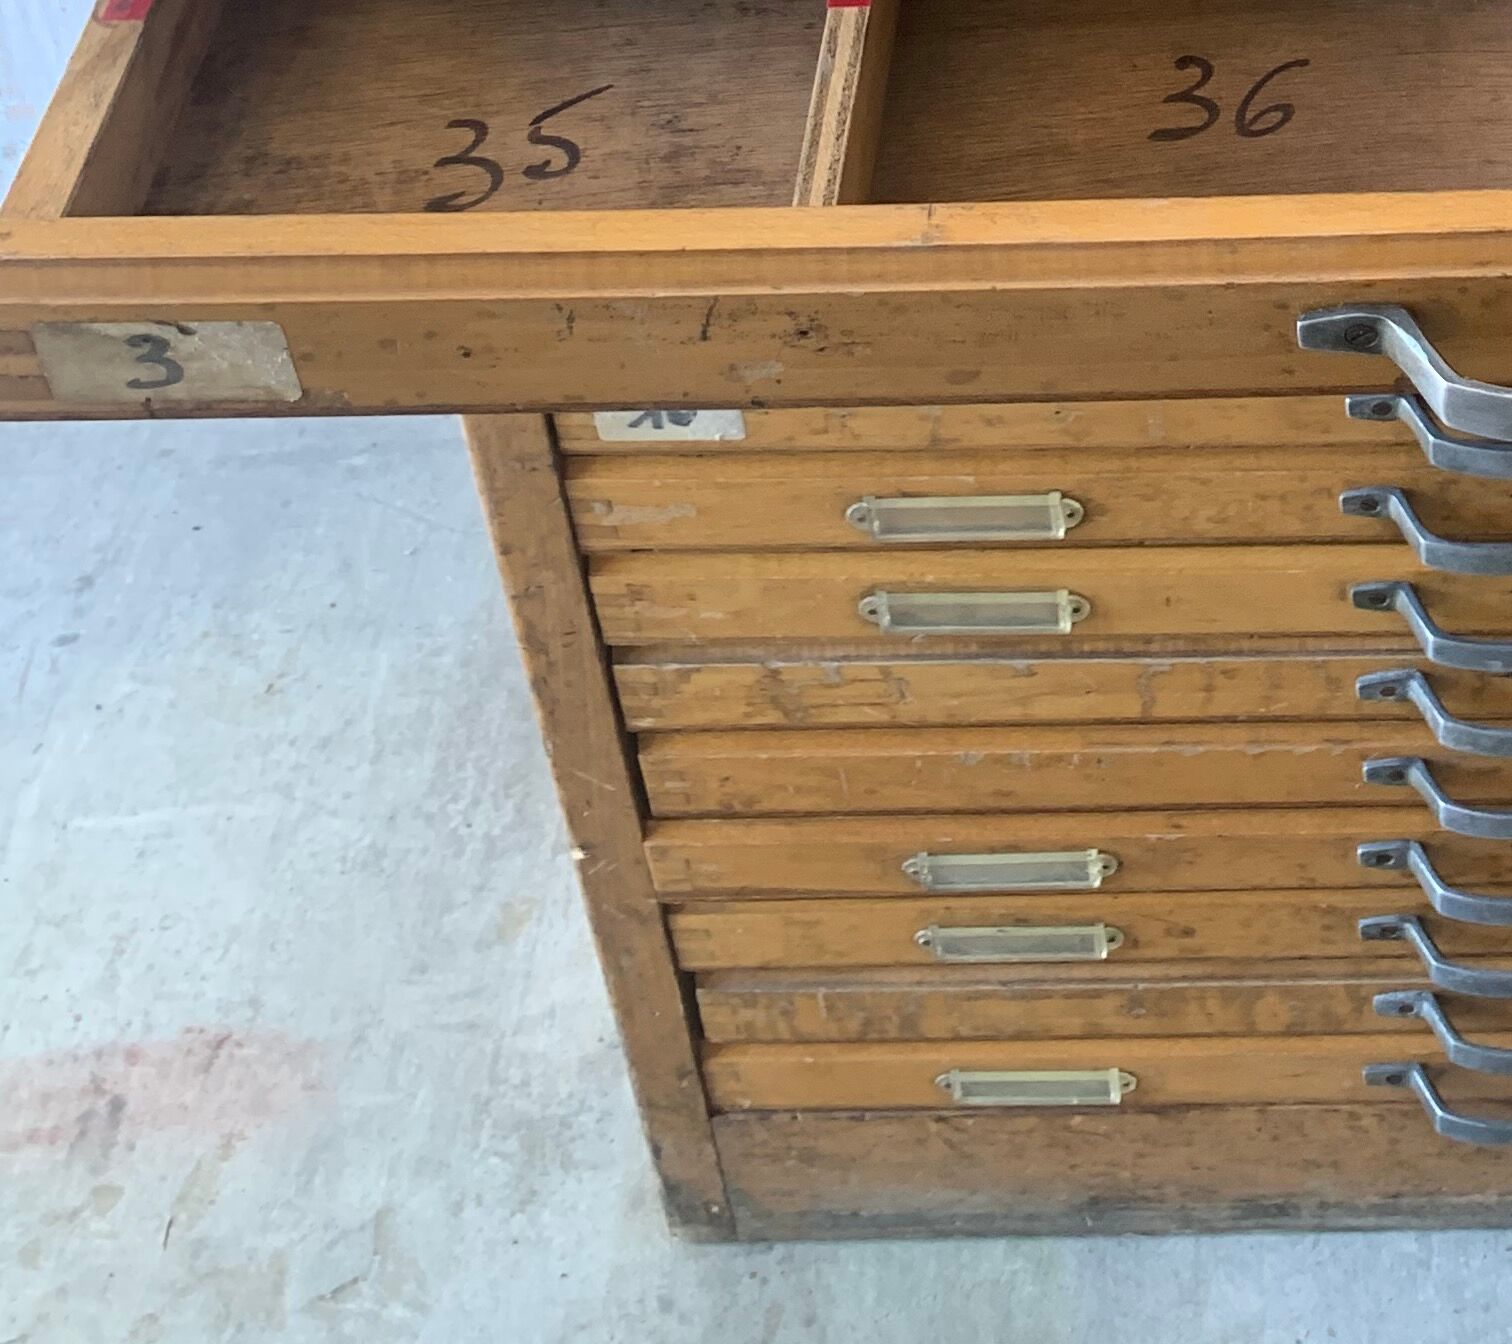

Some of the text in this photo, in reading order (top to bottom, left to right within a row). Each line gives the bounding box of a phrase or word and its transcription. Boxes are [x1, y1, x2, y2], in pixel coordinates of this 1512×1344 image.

[1147, 55, 1312, 141] 36
[422, 83, 615, 213] 35
[124, 333, 184, 389] 3
